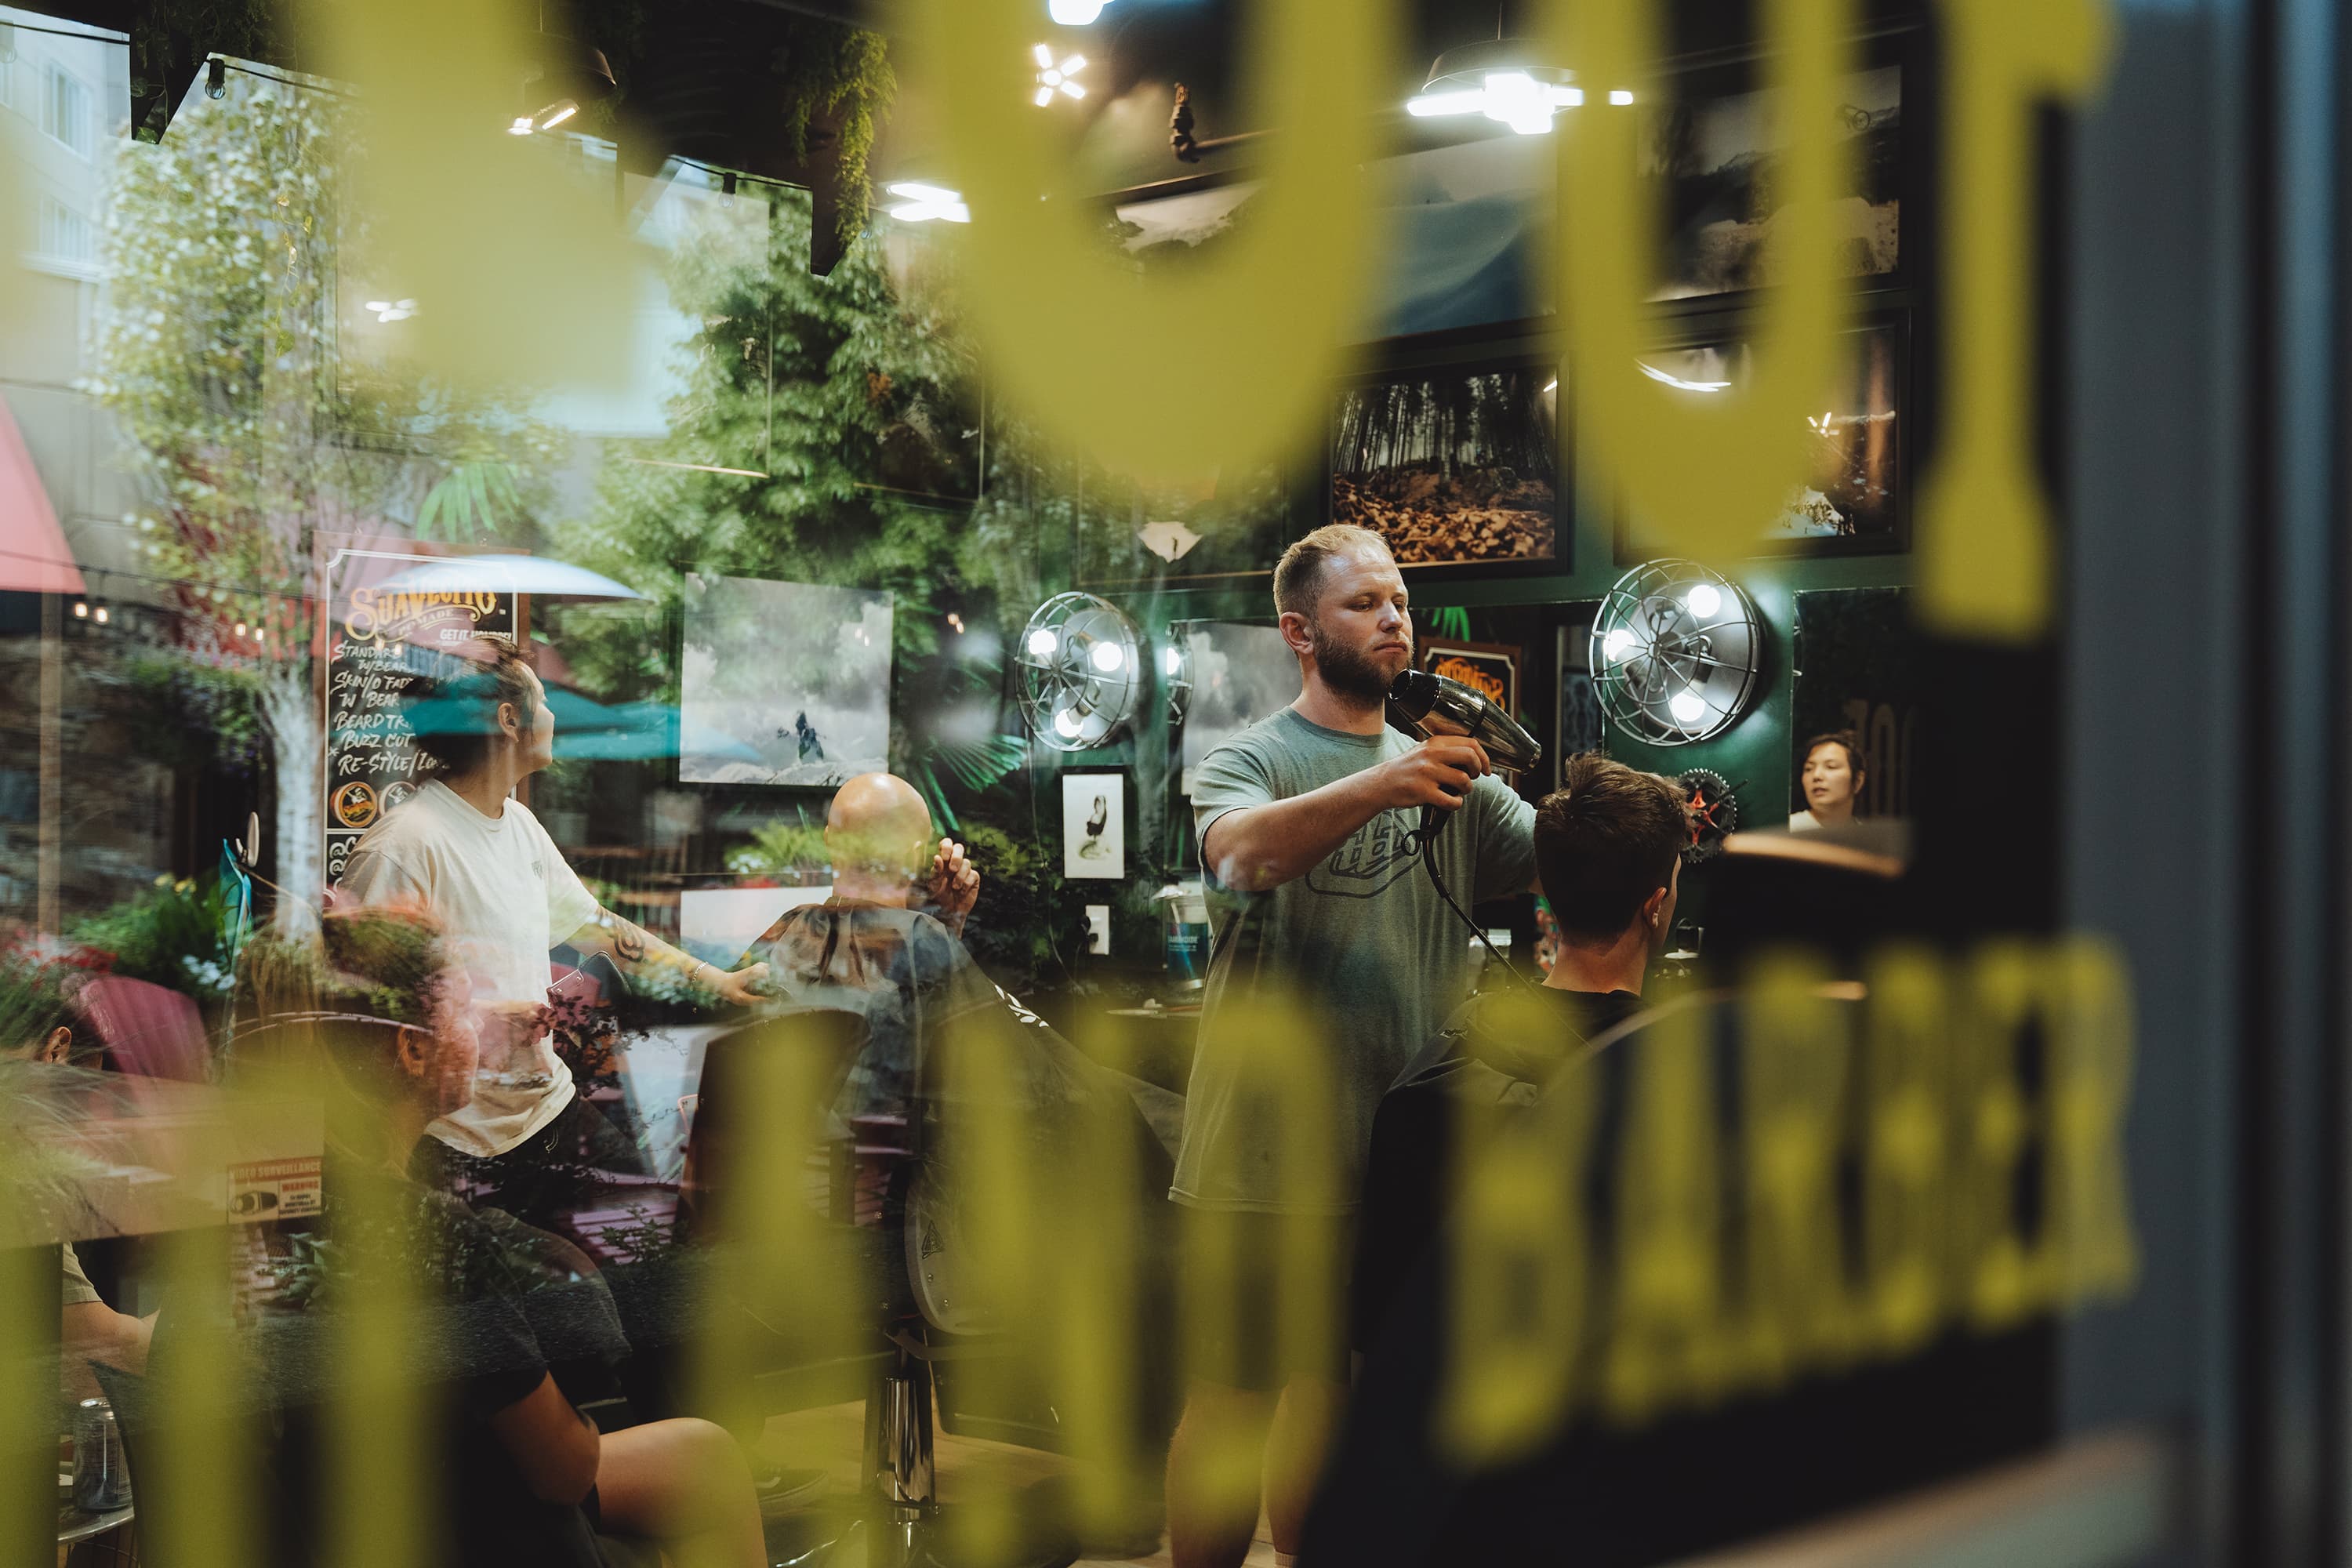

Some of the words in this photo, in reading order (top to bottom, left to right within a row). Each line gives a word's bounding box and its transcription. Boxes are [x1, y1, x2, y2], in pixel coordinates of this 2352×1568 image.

[440, 629, 460, 640] GET
[333, 711, 383, 731] BEARD
[342, 731, 383, 752] BUZZ
[384, 733, 416, 747] CUT
